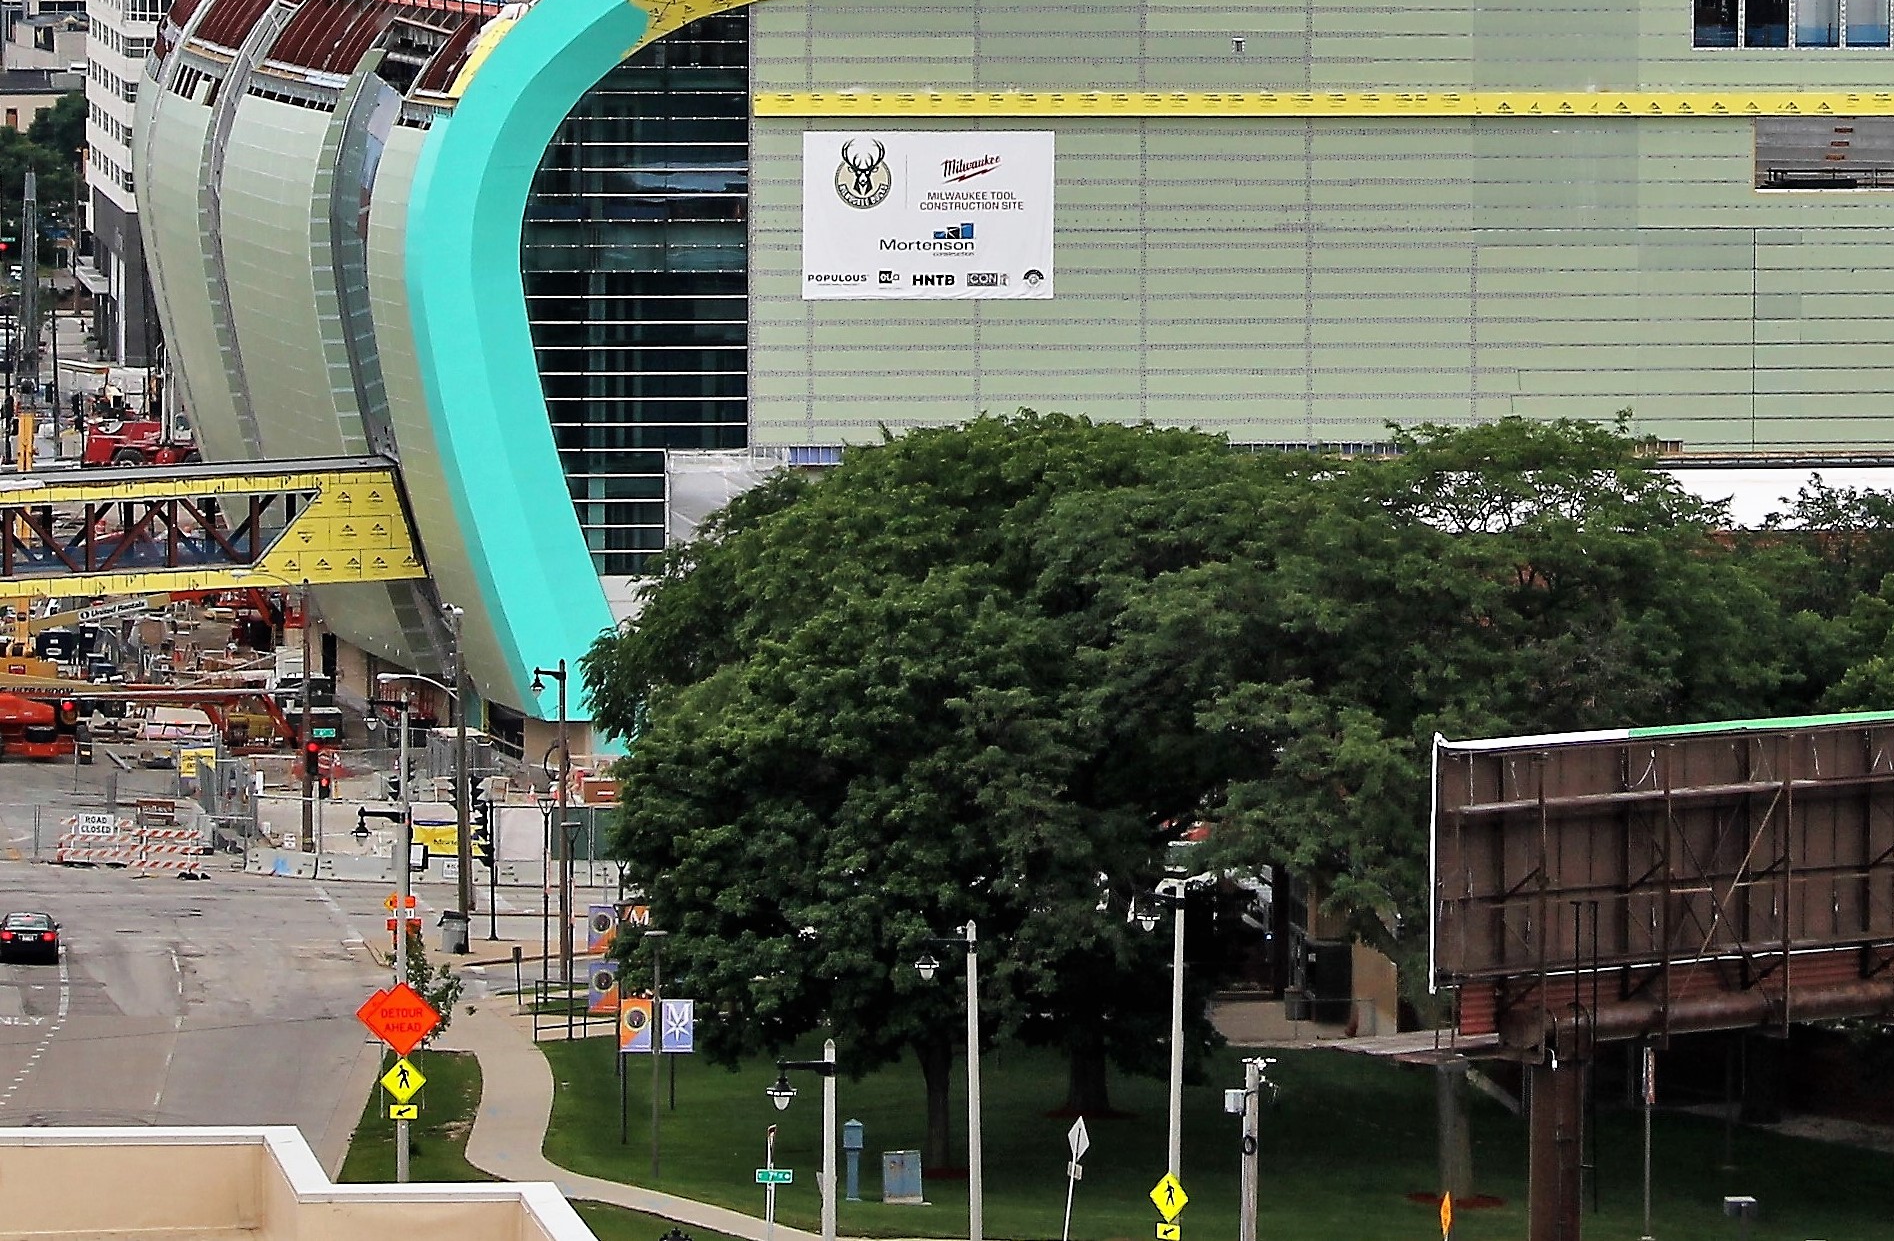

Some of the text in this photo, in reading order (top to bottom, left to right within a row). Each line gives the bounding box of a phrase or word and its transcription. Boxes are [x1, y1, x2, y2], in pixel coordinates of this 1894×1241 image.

[940, 154, 1001, 178] Milwaukee
[927, 191, 1017, 201] MILWAUKEE TOOL
[919, 201, 1024, 211] CONSTRUCTION SITE
[879, 238, 975, 251] Mortenson
[807, 273, 868, 282] POPULOUS
[912, 274, 955, 286] HNTB
[84, 815, 108, 825] ROAD
[80, 824, 112, 835] CLOSED
[381, 1007, 423, 1019] DETOUR
[0, 1016, 45, 1026] NLY
[384, 1022, 422, 1033] AHEAD
